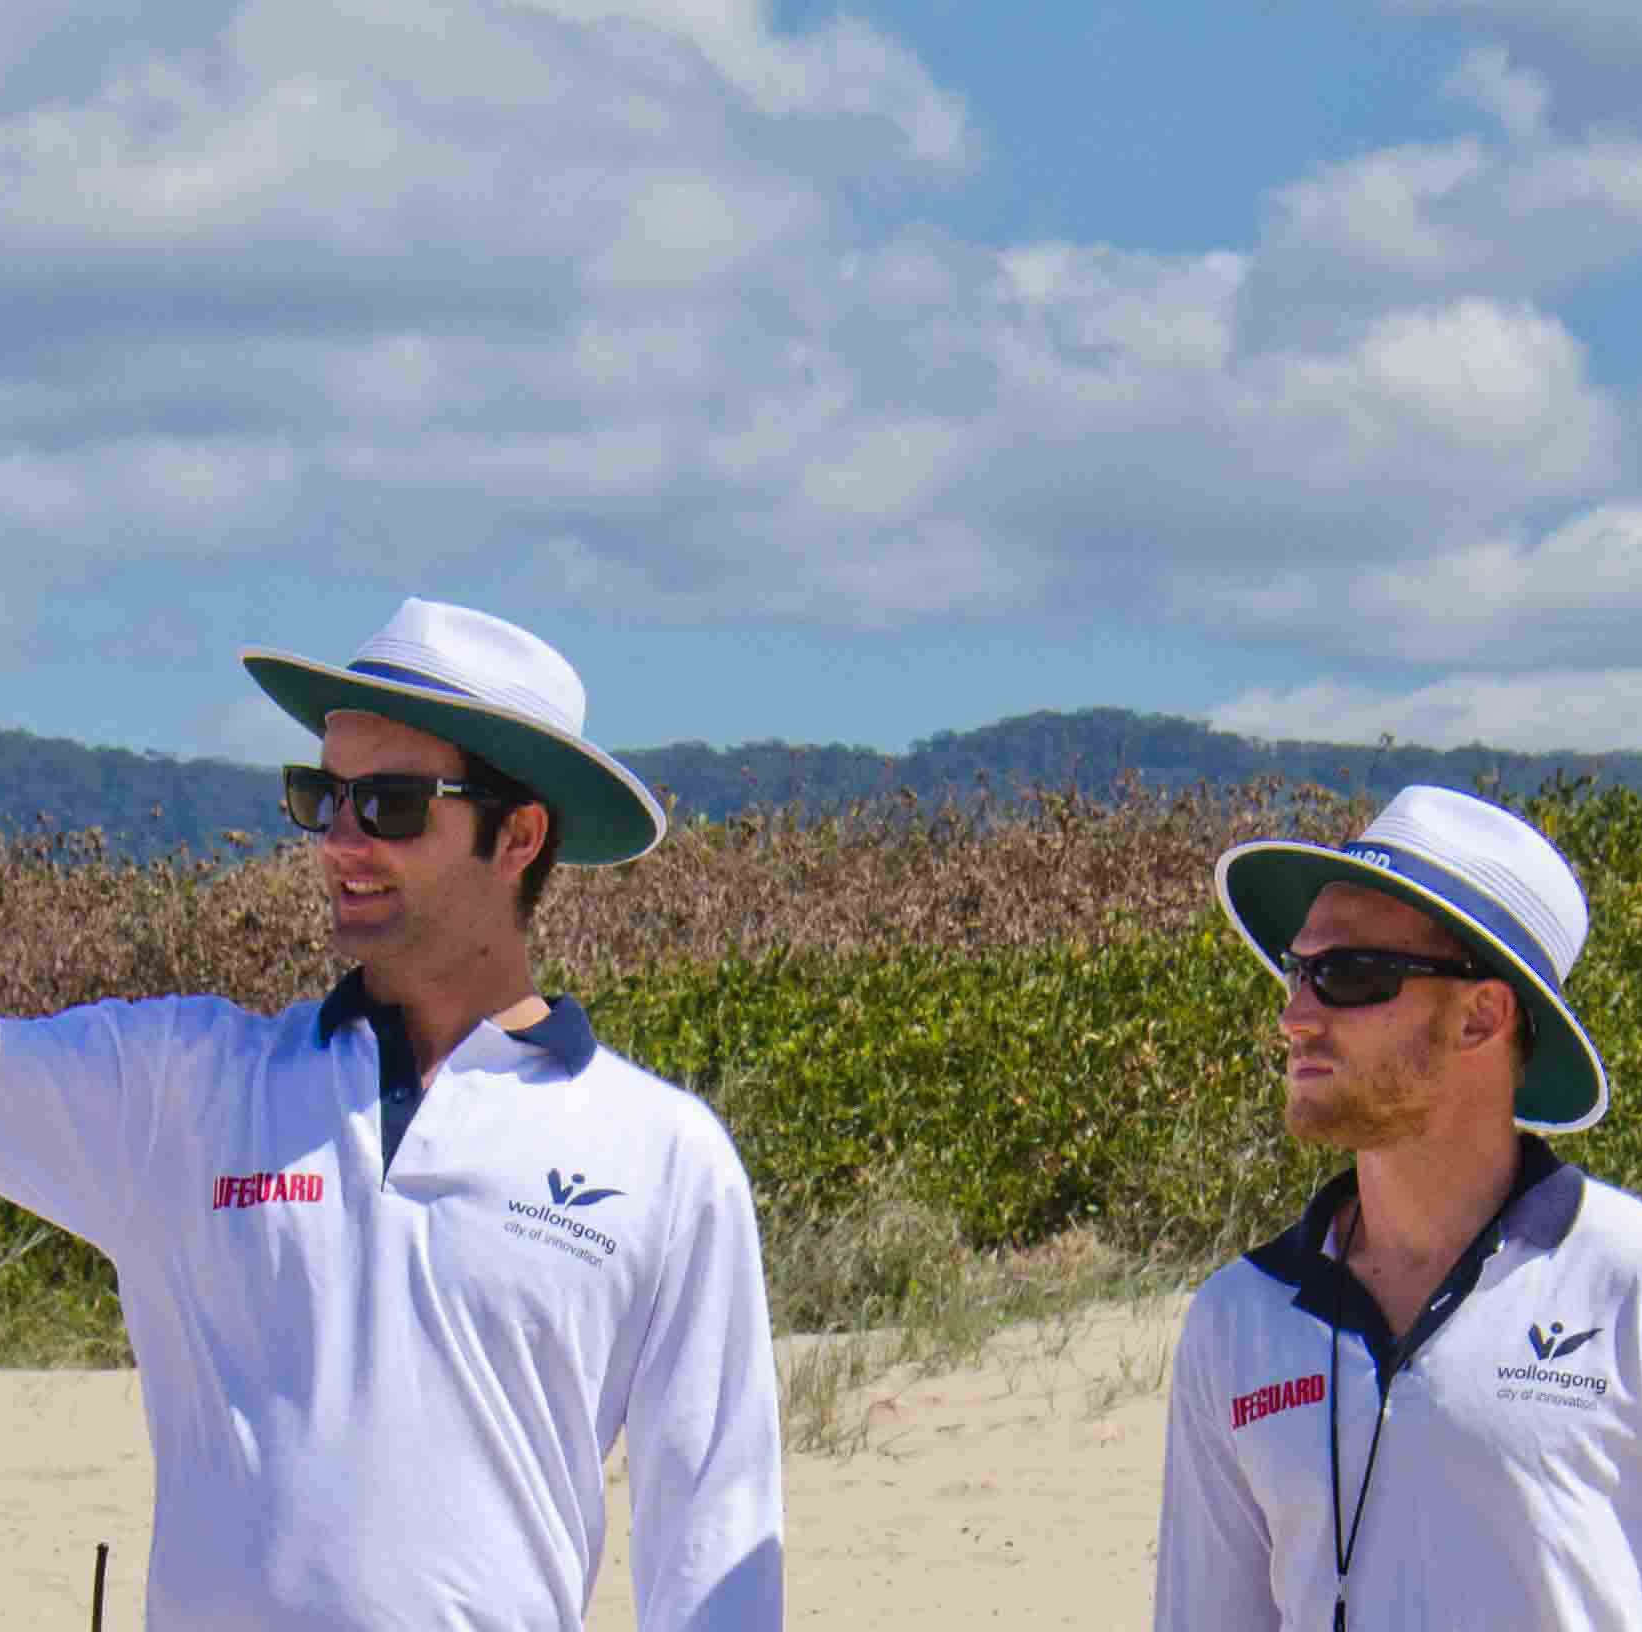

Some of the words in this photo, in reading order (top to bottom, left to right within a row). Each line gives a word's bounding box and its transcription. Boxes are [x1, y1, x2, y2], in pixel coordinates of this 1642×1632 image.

[503, 1221, 526, 1240] city
[528, 1227, 542, 1241] of
[544, 1234, 605, 1269] innovation
[508, 1199, 617, 1255] wollongong
[1495, 1388, 1517, 1401] city
[1520, 1388, 1533, 1401] of
[1497, 1364, 1607, 1394] wollongong
